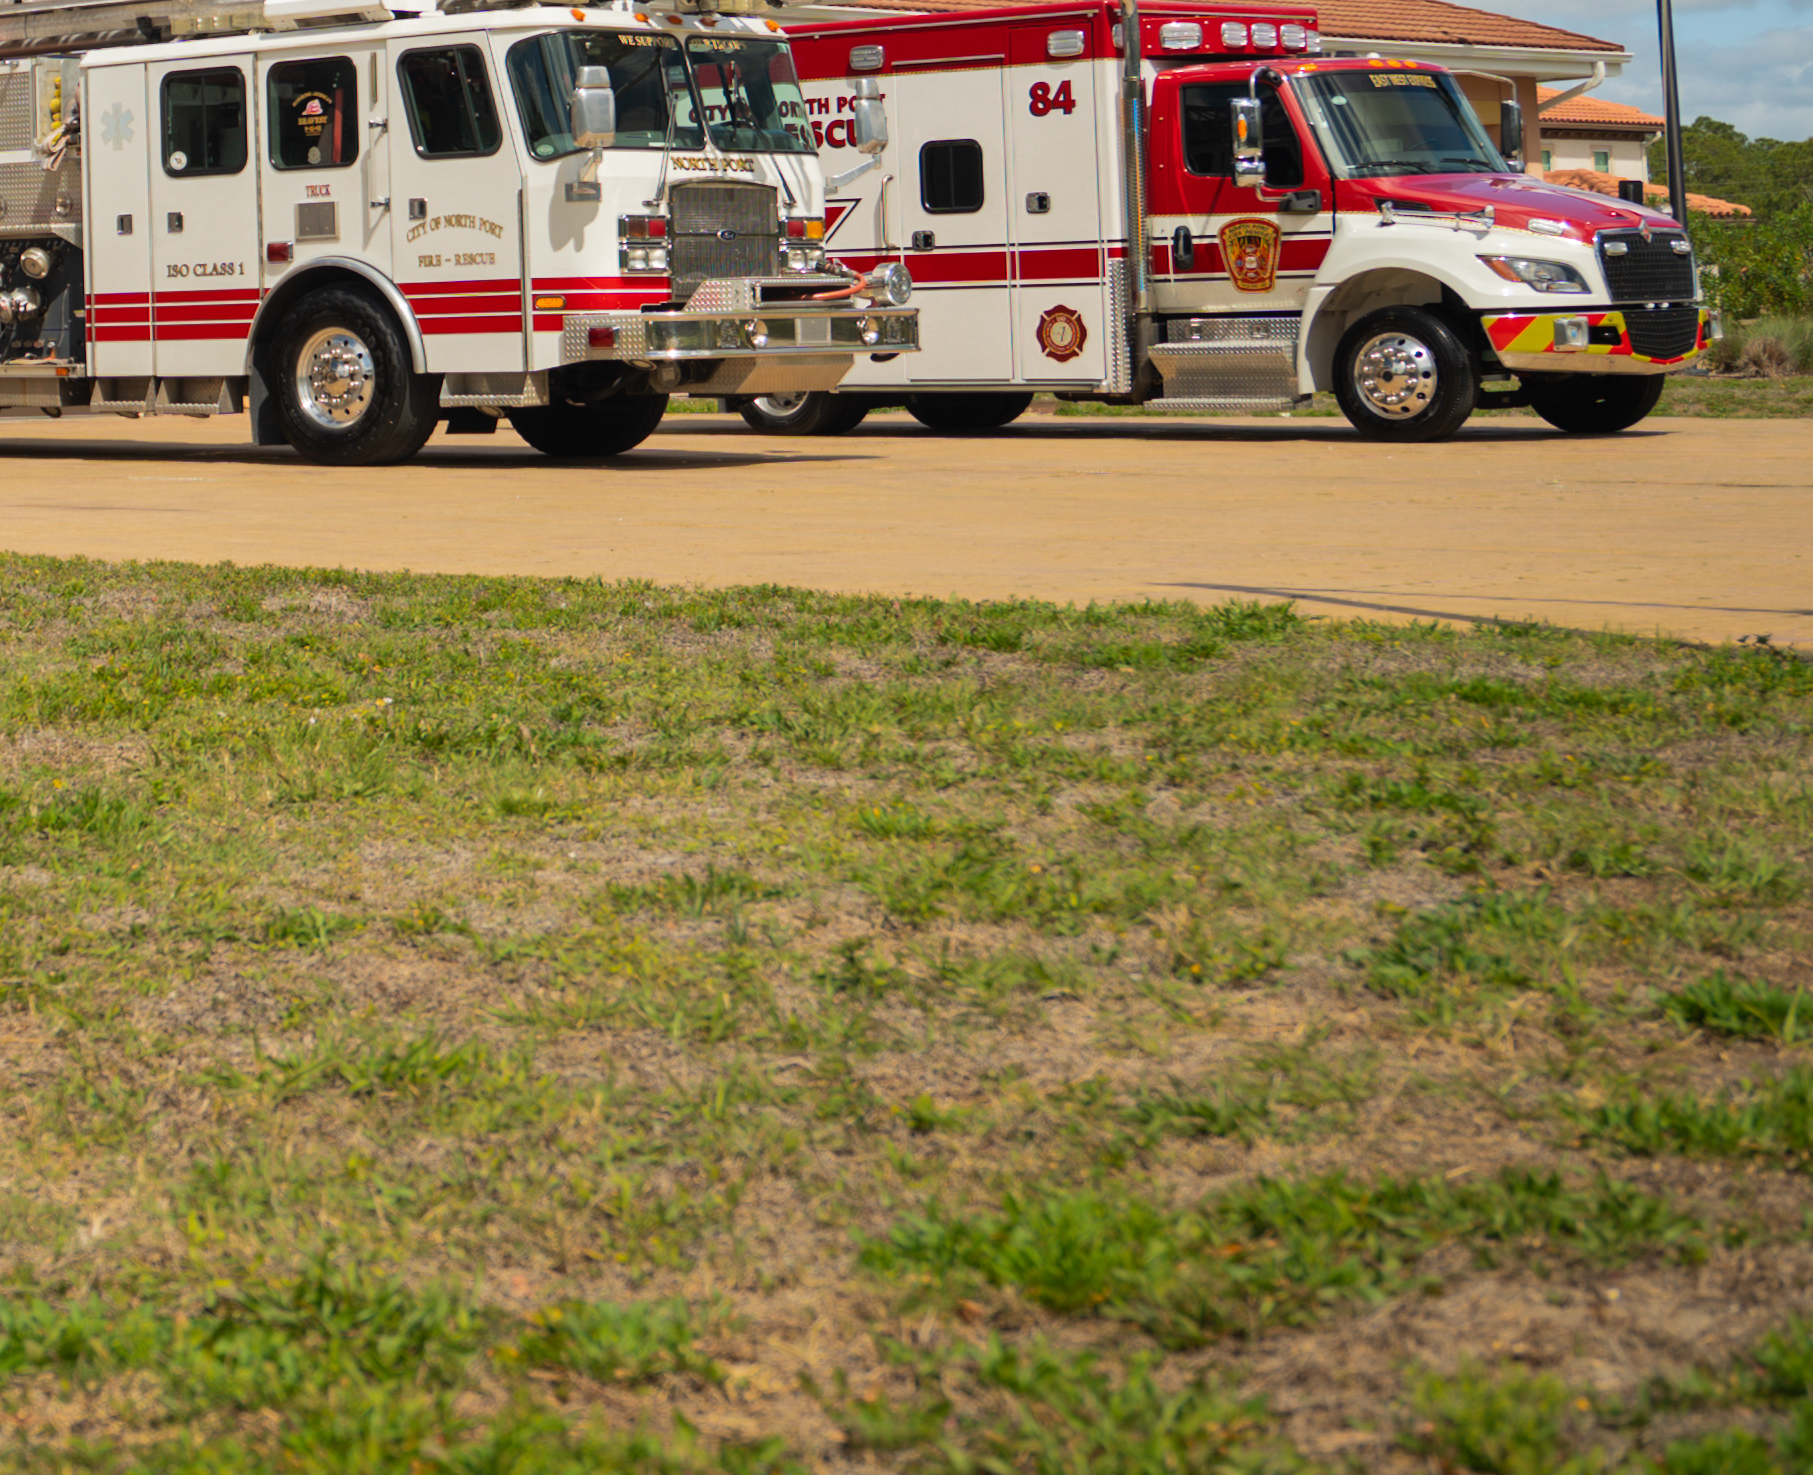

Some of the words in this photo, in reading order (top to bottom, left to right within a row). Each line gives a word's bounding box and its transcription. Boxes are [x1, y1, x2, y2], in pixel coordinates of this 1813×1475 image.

[1029, 79, 1077, 117] 84
[671, 156, 718, 172] NORTH
[721, 157, 755, 173] PORT
[305, 184, 331, 198] TRUCK
[406, 221, 428, 243] CITY
[430, 216, 441, 231] OF
[443, 214, 476, 229] NORTH
[479, 217, 504, 239] PORT
[418, 254, 442, 268] FIRE
[454, 252, 496, 266] RESCUE
[167, 264, 189, 277] ISO
[193, 262, 235, 277] CLASS
[239, 262, 245, 275] 1
